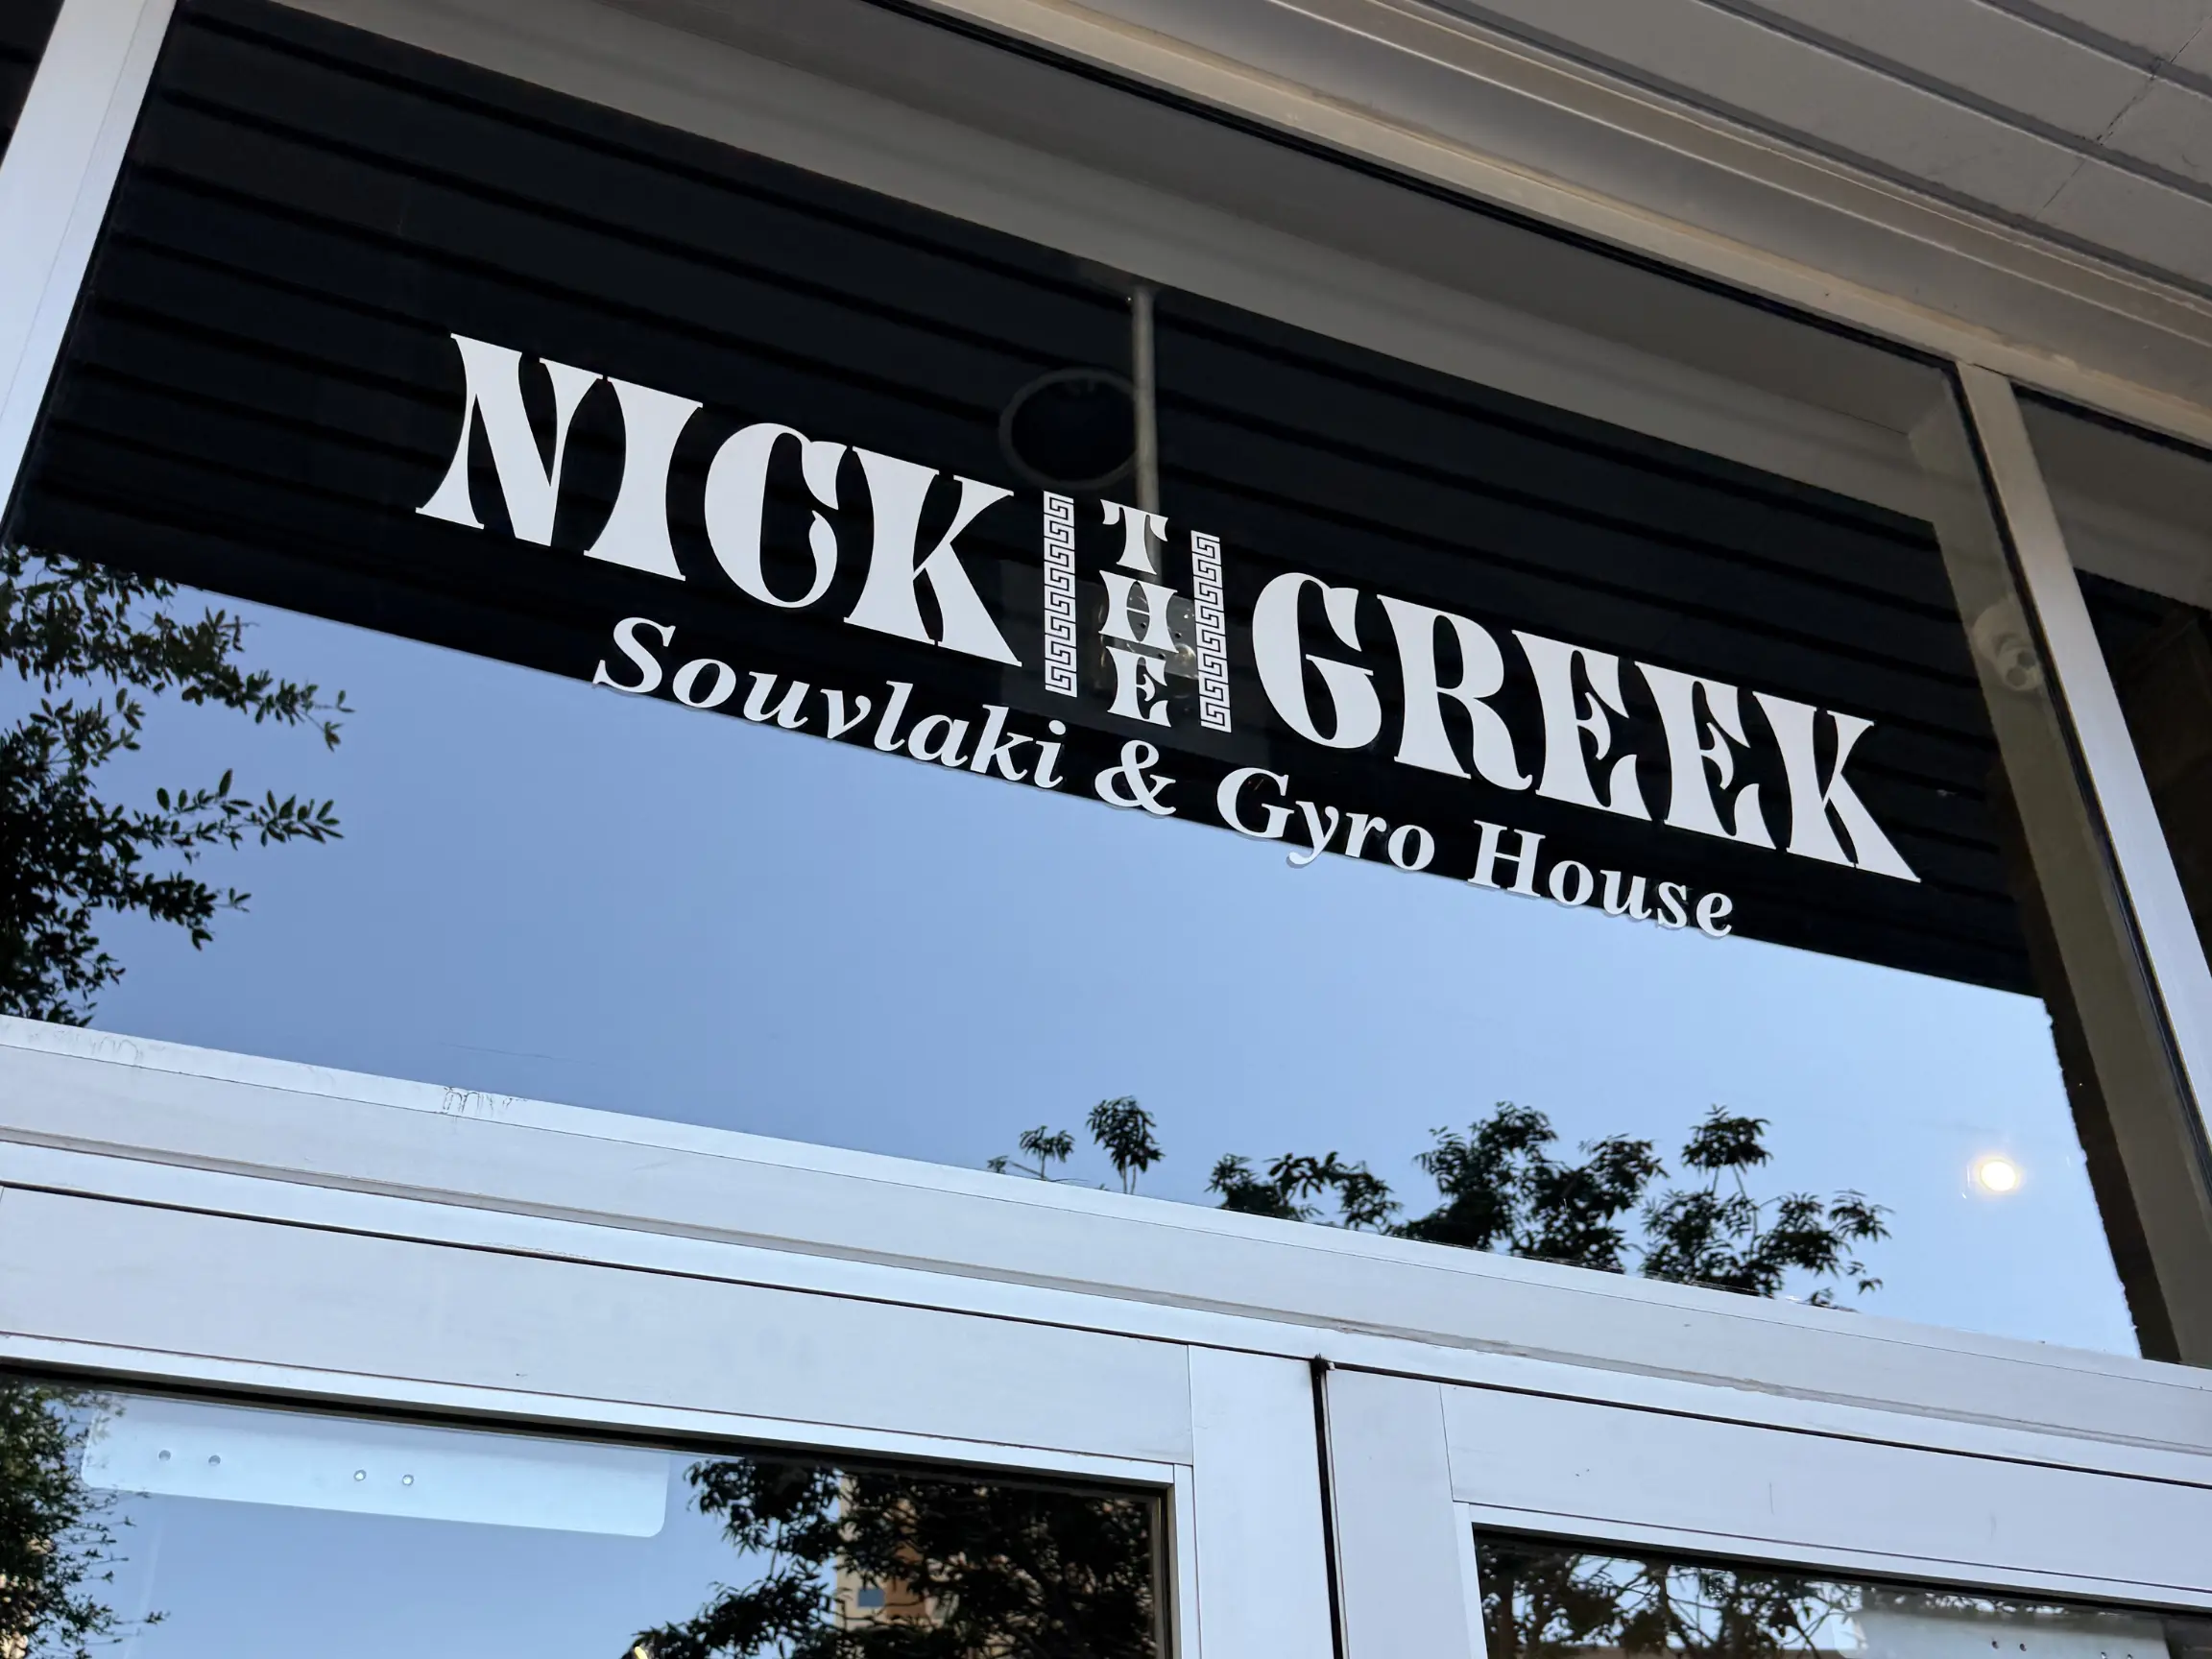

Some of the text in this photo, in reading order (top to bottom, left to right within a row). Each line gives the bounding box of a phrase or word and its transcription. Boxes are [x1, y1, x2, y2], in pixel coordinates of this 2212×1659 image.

[416, 333, 1921, 883] NICK THE GREEK
[592, 616, 1733, 938] Souvlaki & Gyro House
